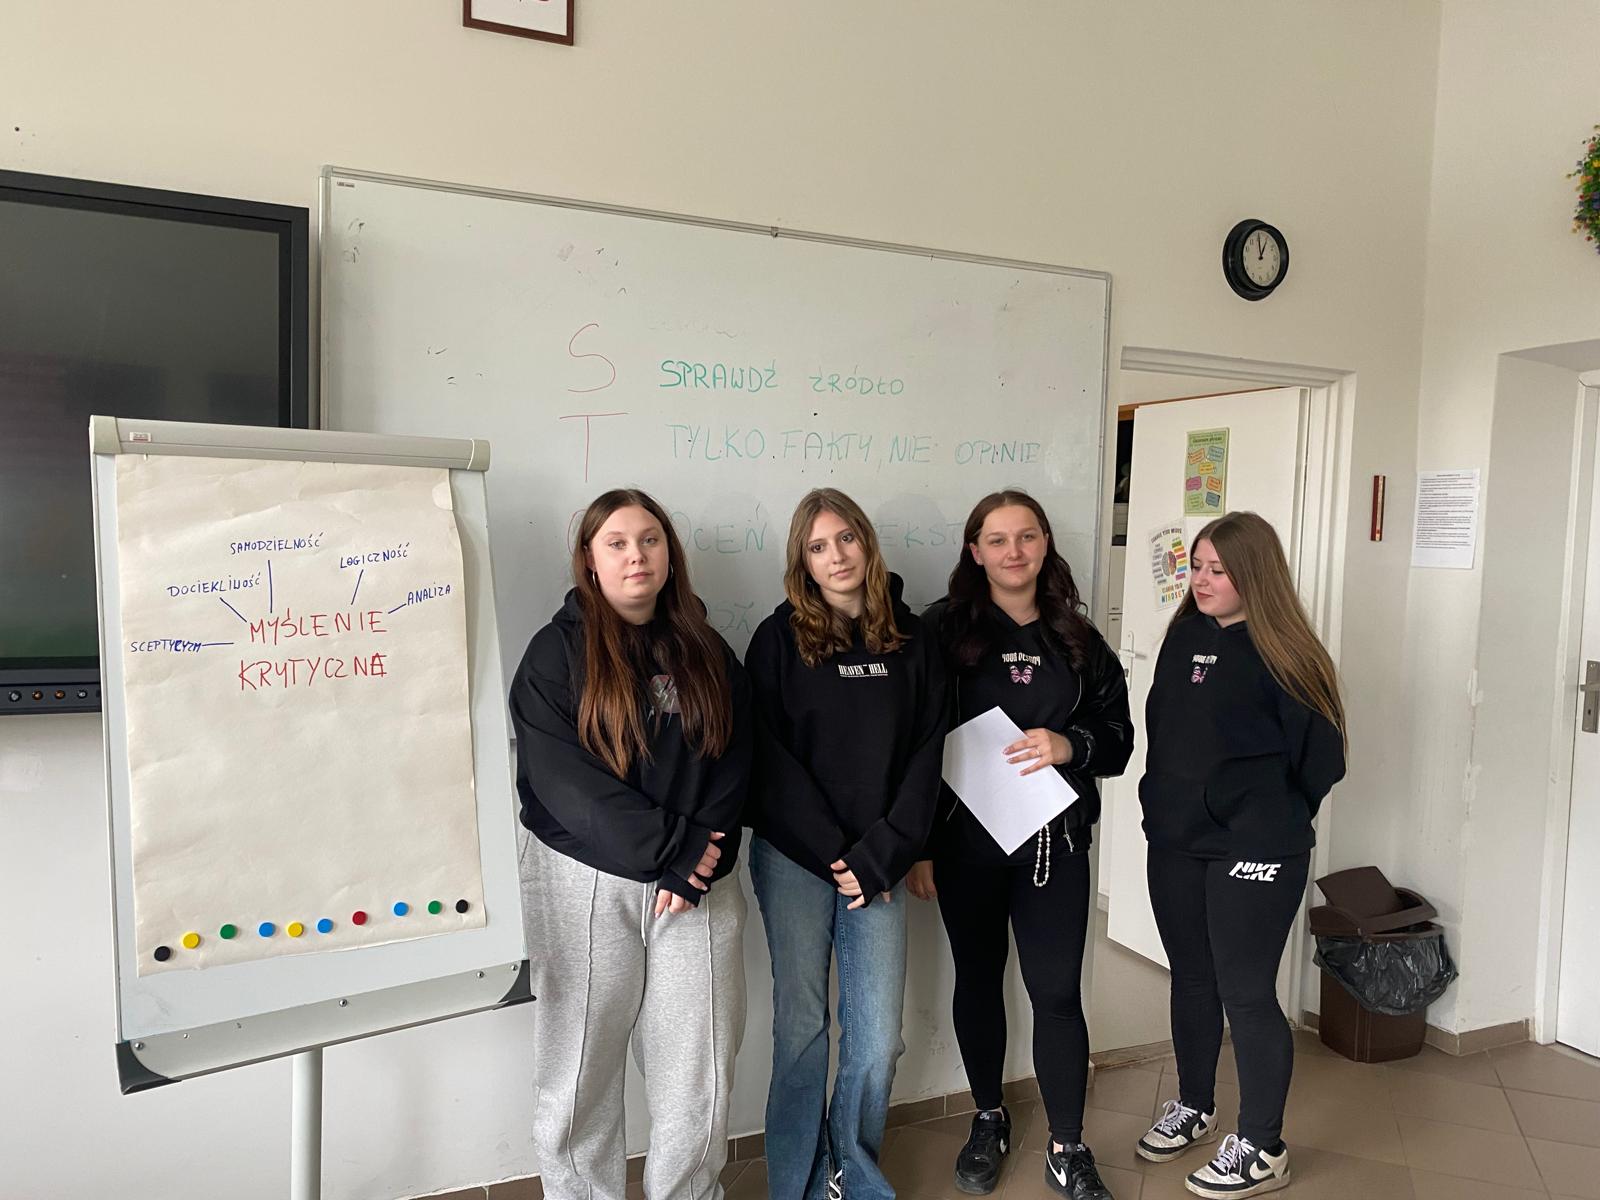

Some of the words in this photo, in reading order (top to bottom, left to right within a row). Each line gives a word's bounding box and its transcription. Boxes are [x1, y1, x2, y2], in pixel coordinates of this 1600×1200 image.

[568, 323, 616, 393] S
[659, 359, 779, 393] SPRAWDŹ
[559, 412, 629, 483] T
[665, 423, 766, 461] TYLKO
[889, 435, 932, 463] NIE
[955, 440, 1041, 465] OPINIE
[230, 531, 324, 555] SAMODZIELNOŚĆ
[340, 542, 410, 569] LOGICZNOŚĆ
[407, 581, 451, 606] ANALIZA
[249, 608, 388, 645] MYŚLENIE
[1228, 861, 1282, 882] NIKE
